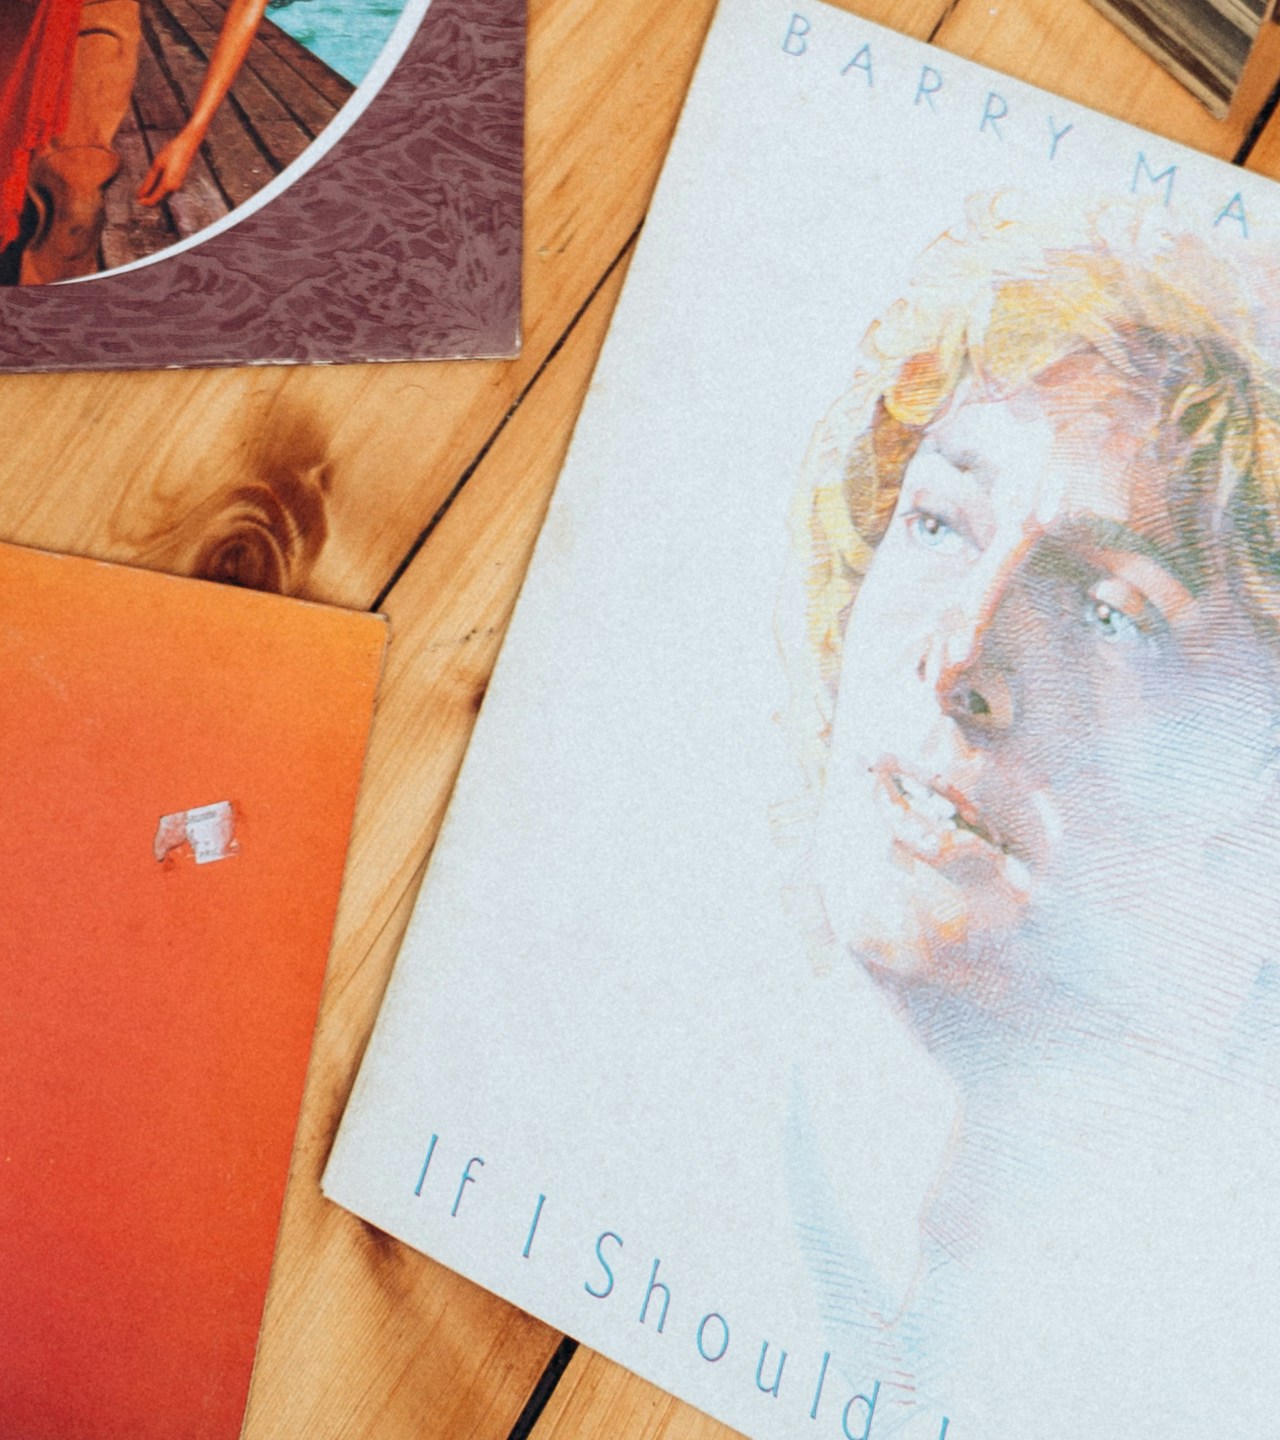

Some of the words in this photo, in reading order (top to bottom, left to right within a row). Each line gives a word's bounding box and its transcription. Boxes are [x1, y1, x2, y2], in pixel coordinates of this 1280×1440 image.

[780, 8, 1077, 165] BARRY
[409, 1129, 488, 1224] If
[518, 1193, 547, 1262] I
[583, 1225, 889, 1440] Should
